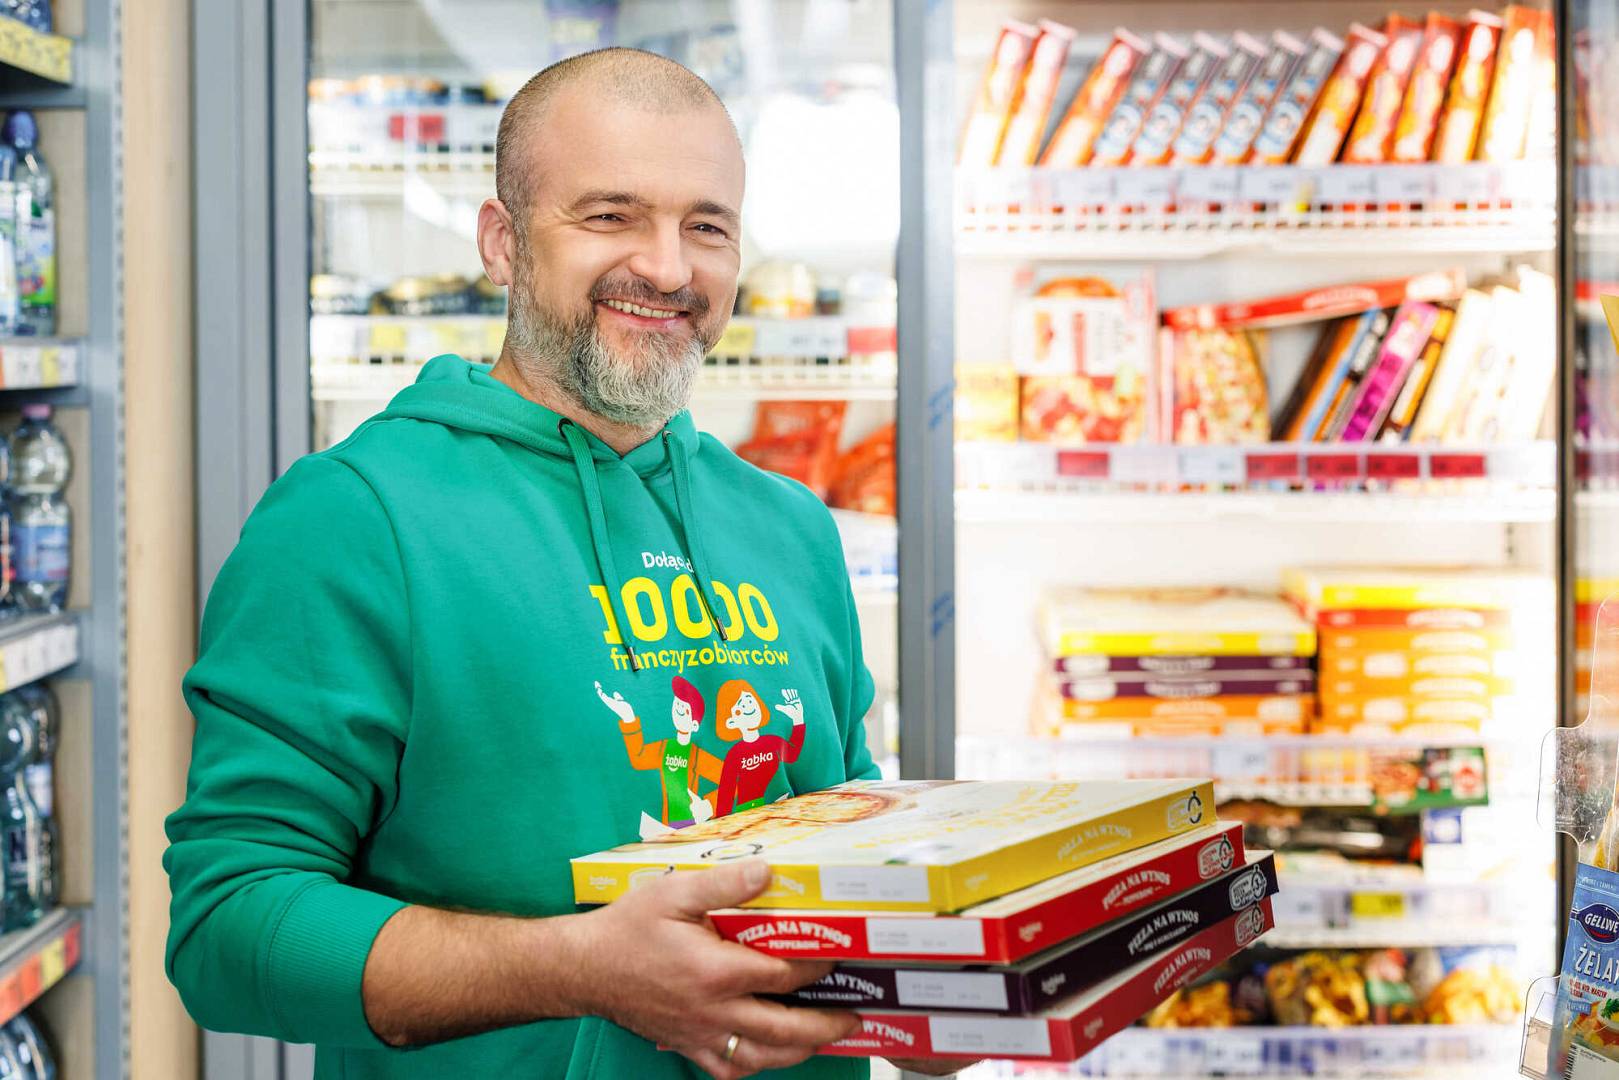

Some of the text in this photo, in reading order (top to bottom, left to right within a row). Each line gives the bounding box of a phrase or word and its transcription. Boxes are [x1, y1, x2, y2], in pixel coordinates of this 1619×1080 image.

[588, 574, 780, 645] 10000
[664, 753, 688, 769] żabka
[741, 751, 774, 769] żabka
[1102, 881, 1128, 911] PIZZA
[1126, 872, 1142, 889] NA
[1140, 869, 1171, 887] WYNOS
[736, 922, 777, 946] PIZZA
[776, 919, 800, 935] NA
[799, 920, 853, 949] WYNOS
[1128, 923, 1155, 955] PIZZA
[1153, 914, 1169, 932] NA
[1167, 909, 1199, 925] WYNOS
[1584, 912, 1619, 935] GELLWE
[1154, 962, 1177, 995] PIZZA
[1173, 953, 1188, 970] NA
[1185, 947, 1212, 961] WYNOS
[834, 972, 885, 1000] WYNOS
[862, 1019, 915, 1047] WYNOS
